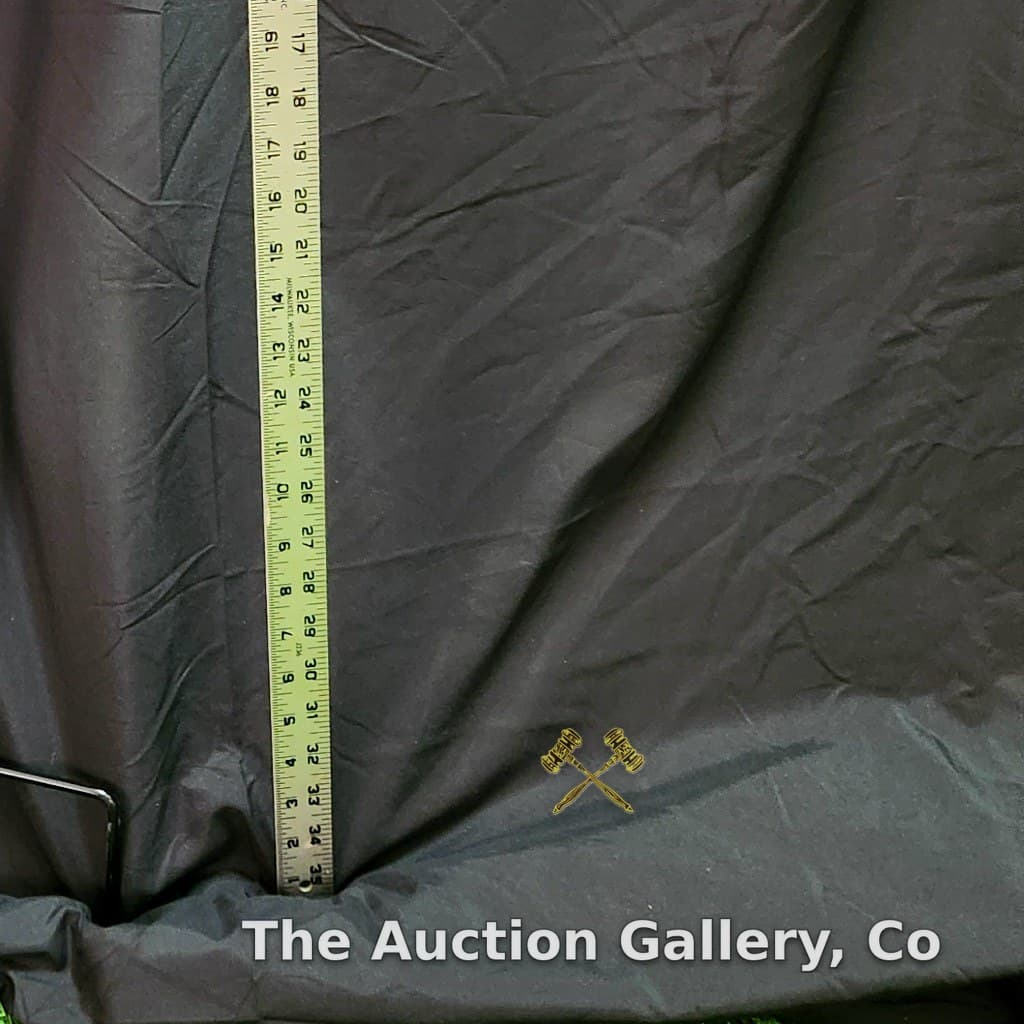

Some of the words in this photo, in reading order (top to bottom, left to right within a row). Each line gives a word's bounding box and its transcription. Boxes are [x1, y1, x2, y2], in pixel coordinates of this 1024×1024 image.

[266, 31, 278, 52] 19
[294, 32, 306, 53] 17
[267, 86, 279, 106] 18
[294, 86, 307, 108] 18
[268, 139, 280, 159] 17
[295, 140, 307, 161] 19
[269, 192, 281, 211] 16
[295, 189, 307, 214] 20
[270, 243, 282, 262] 15
[296, 239, 308, 260] 21
[271, 293, 283, 312] 14
[297, 289, 309, 314] 22
[273, 342, 285, 361] 13
[298, 338, 309, 362] 23
[275, 389, 286, 408] 12
[299, 386, 310, 410] 24
[276, 441, 288, 456] 11
[300, 433, 311, 457] 25
[277, 483, 289, 501] 10
[301, 480, 312, 503] 26
[279, 542, 290, 552] 9
[302, 526, 313, 548] 27
[280, 586, 292, 596] 8
[303, 571, 314, 593] 28
[282, 630, 293, 640] 7
[304, 615, 315, 637] 29
[283, 674, 294, 684] 6
[305, 658, 316, 681] 30
[306, 701, 317, 719] 31
[284, 717, 295, 727] 5
[285, 758, 296, 767] 4
[307, 744, 318, 765] 32
[286, 798, 297, 809] 3
[308, 784, 319, 806] 33
[287, 839, 298, 849] 2
[309, 824, 320, 846] 34
[310, 864, 321, 885] 35
